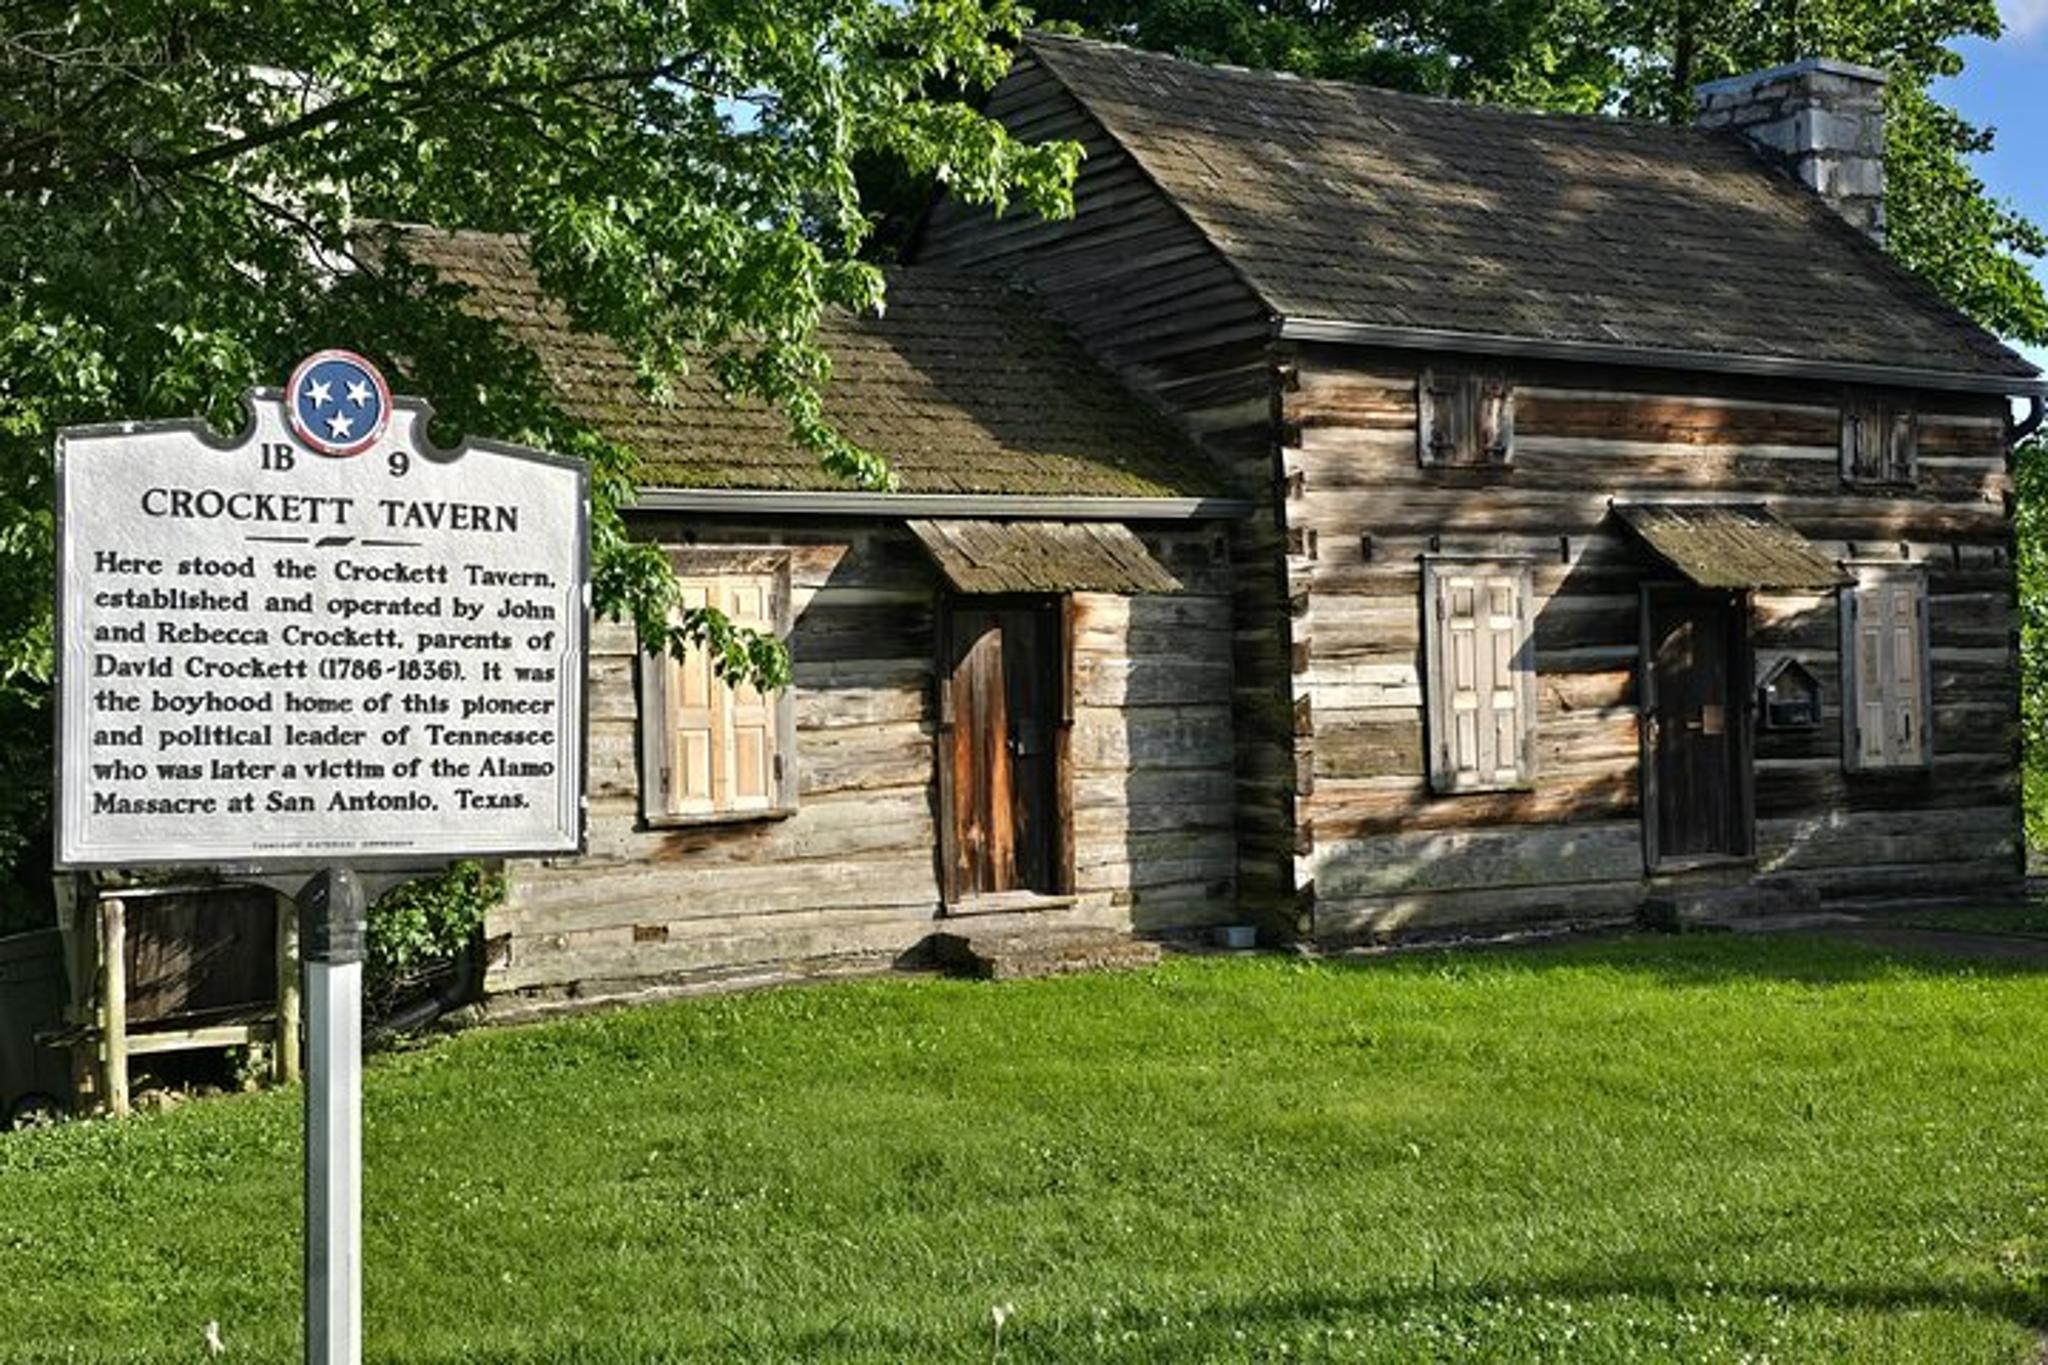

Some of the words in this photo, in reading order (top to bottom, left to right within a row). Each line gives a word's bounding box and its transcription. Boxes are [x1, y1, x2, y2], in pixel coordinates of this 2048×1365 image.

[261, 443, 295, 471] 1B
[388, 451, 410, 477] 9
[141, 488, 354, 525] CROCKETT
[378, 499, 518, 532] TAVERN
[94, 550, 163, 575] Here
[178, 556, 255, 578] stood
[273, 558, 317, 580] the
[334, 559, 448, 584] Crockett
[94, 587, 249, 612] established
[264, 592, 313, 613] and
[326, 596, 442, 619] operated
[452, 597, 484, 621] by
[497, 598, 555, 620] John
[94, 620, 146, 643] and
[157, 621, 269, 645] Rebecca
[417, 631, 512, 653] parents
[526, 630, 555, 651] of
[93, 654, 173, 678] David
[184, 656, 308, 679] Crockett
[482, 661, 502, 681] It
[514, 667, 555, 683] was
[93, 689, 141, 712] the
[151, 689, 273, 716] boyhood
[285, 691, 353, 713] home
[362, 692, 393, 713] of
[401, 693, 450, 714] this
[462, 695, 555, 720] pioneer
[93, 724, 143, 746] and
[158, 724, 272, 752] political
[285, 724, 367, 746] leader
[381, 724, 411, 746] of
[424, 724, 555, 746] Tennessee
[92, 759, 148, 781] who
[155, 764, 203, 780] was
[210, 759, 276, 780] later
[281, 764, 297, 779] a
[303, 758, 385, 779] victim
[392, 757, 423, 778] of
[430, 757, 470, 778] the
[478, 757, 555, 778] Alamo
[93, 791, 217, 815] Massacre
[227, 792, 255, 813] at
[265, 790, 316, 813] San
[454, 789, 530, 810] Texas.
